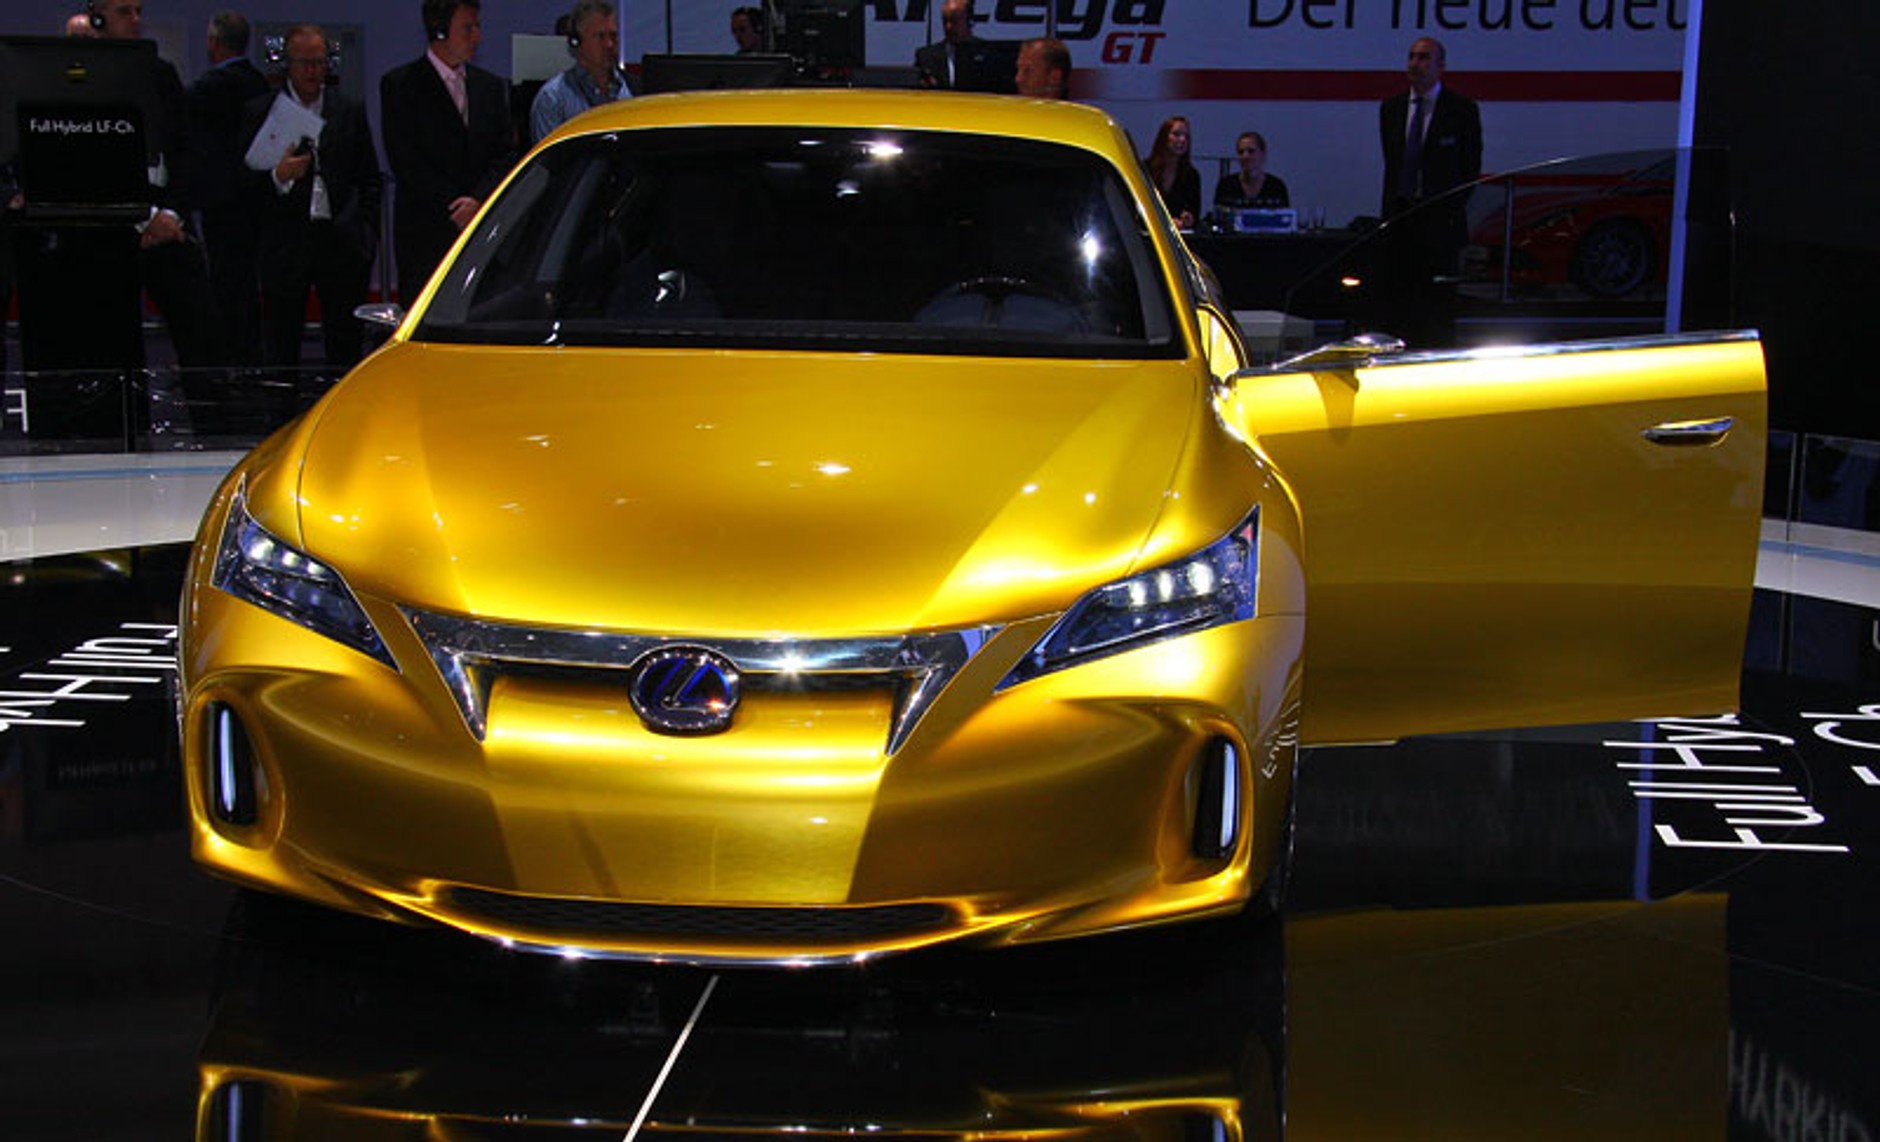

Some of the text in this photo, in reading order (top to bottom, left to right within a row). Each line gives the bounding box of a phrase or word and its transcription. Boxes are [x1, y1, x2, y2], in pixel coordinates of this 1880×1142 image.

[1102, 32, 1166, 64] GT
[30, 118, 50, 133] Full
[53, 119, 93, 135] Hybrid
[1602, 712, 1849, 853] Full Hy
